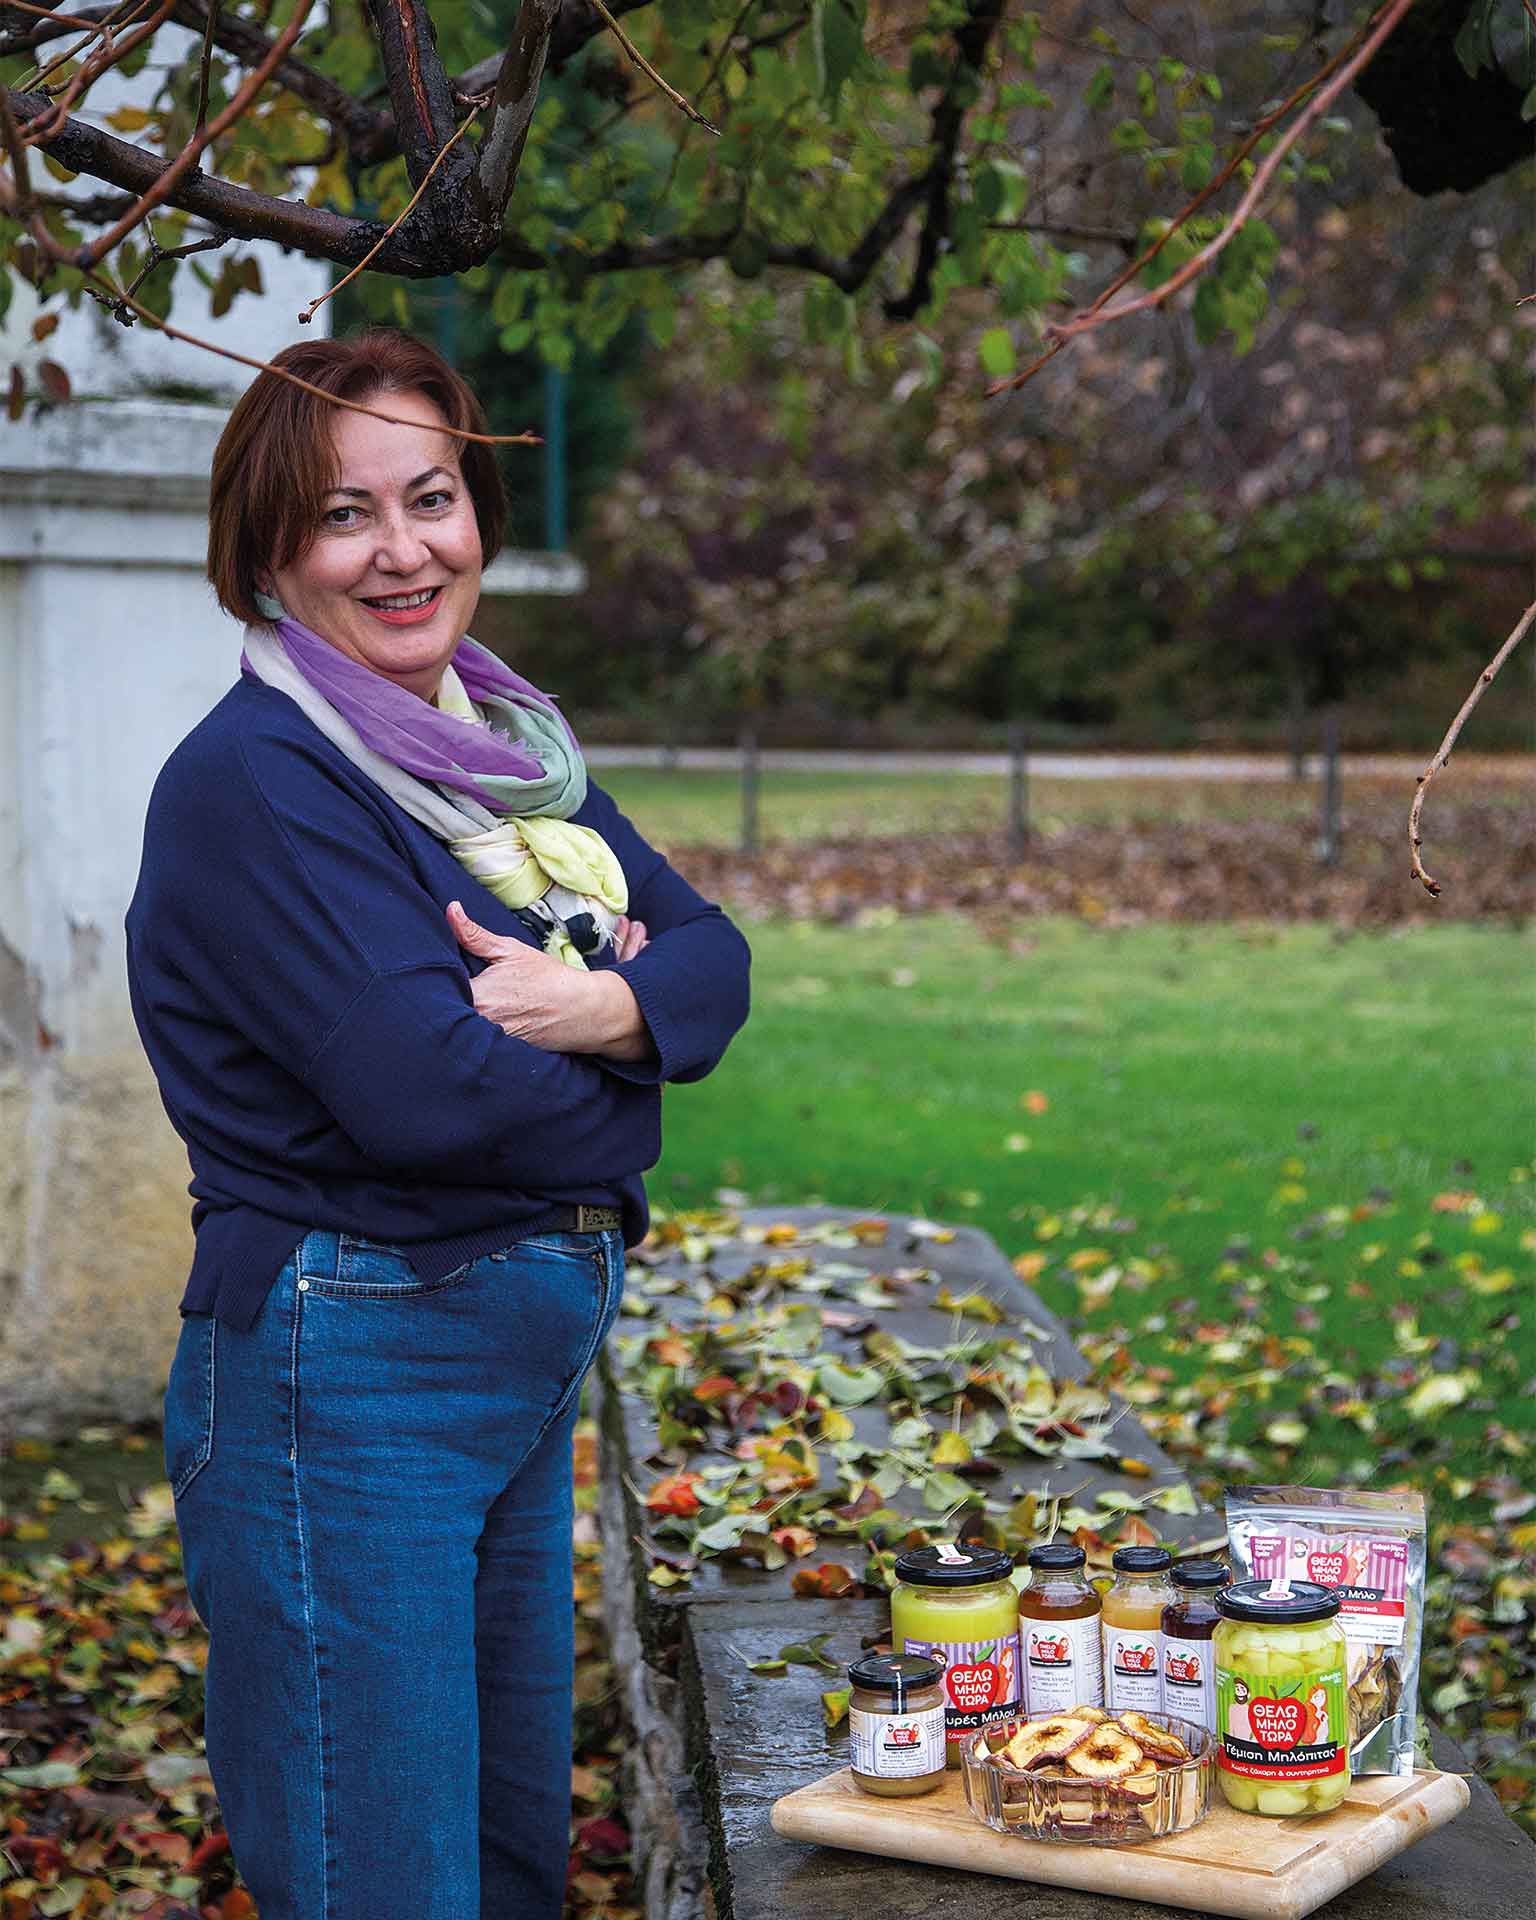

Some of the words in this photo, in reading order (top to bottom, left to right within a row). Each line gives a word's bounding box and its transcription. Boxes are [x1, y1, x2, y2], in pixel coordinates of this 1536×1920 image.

[1310, 1556, 1343, 1567] ΘΕΛΩ
[1311, 1566, 1341, 1575] ΜΗΛΟ
[1314, 1574, 1338, 1584] ΤΩΡΑ
[1348, 1589, 1377, 1600] Μήλο
[952, 1669, 993, 1684] ΘΕΛΩ
[954, 1683, 991, 1696] ΜΗΛΟ
[958, 1695, 989, 1706] ΤΩΡΑ
[1253, 1704, 1298, 1718] ΘΕΛΩ
[946, 1714, 978, 1727] υρές
[981, 1709, 1016, 1723] Μήλου
[1256, 1719, 1297, 1731] ΜΗΛΟ
[1260, 1730, 1294, 1743] ΤΩΡΑ
[1226, 1743, 1263, 1761] Γέμιση
[1268, 1748, 1336, 1763] Μηλόπιτας
[1249, 1767, 1277, 1777] ζάχαρη
[1277, 1769, 1284, 1777] &
[1285, 1766, 1329, 1777] συντηρητικά
